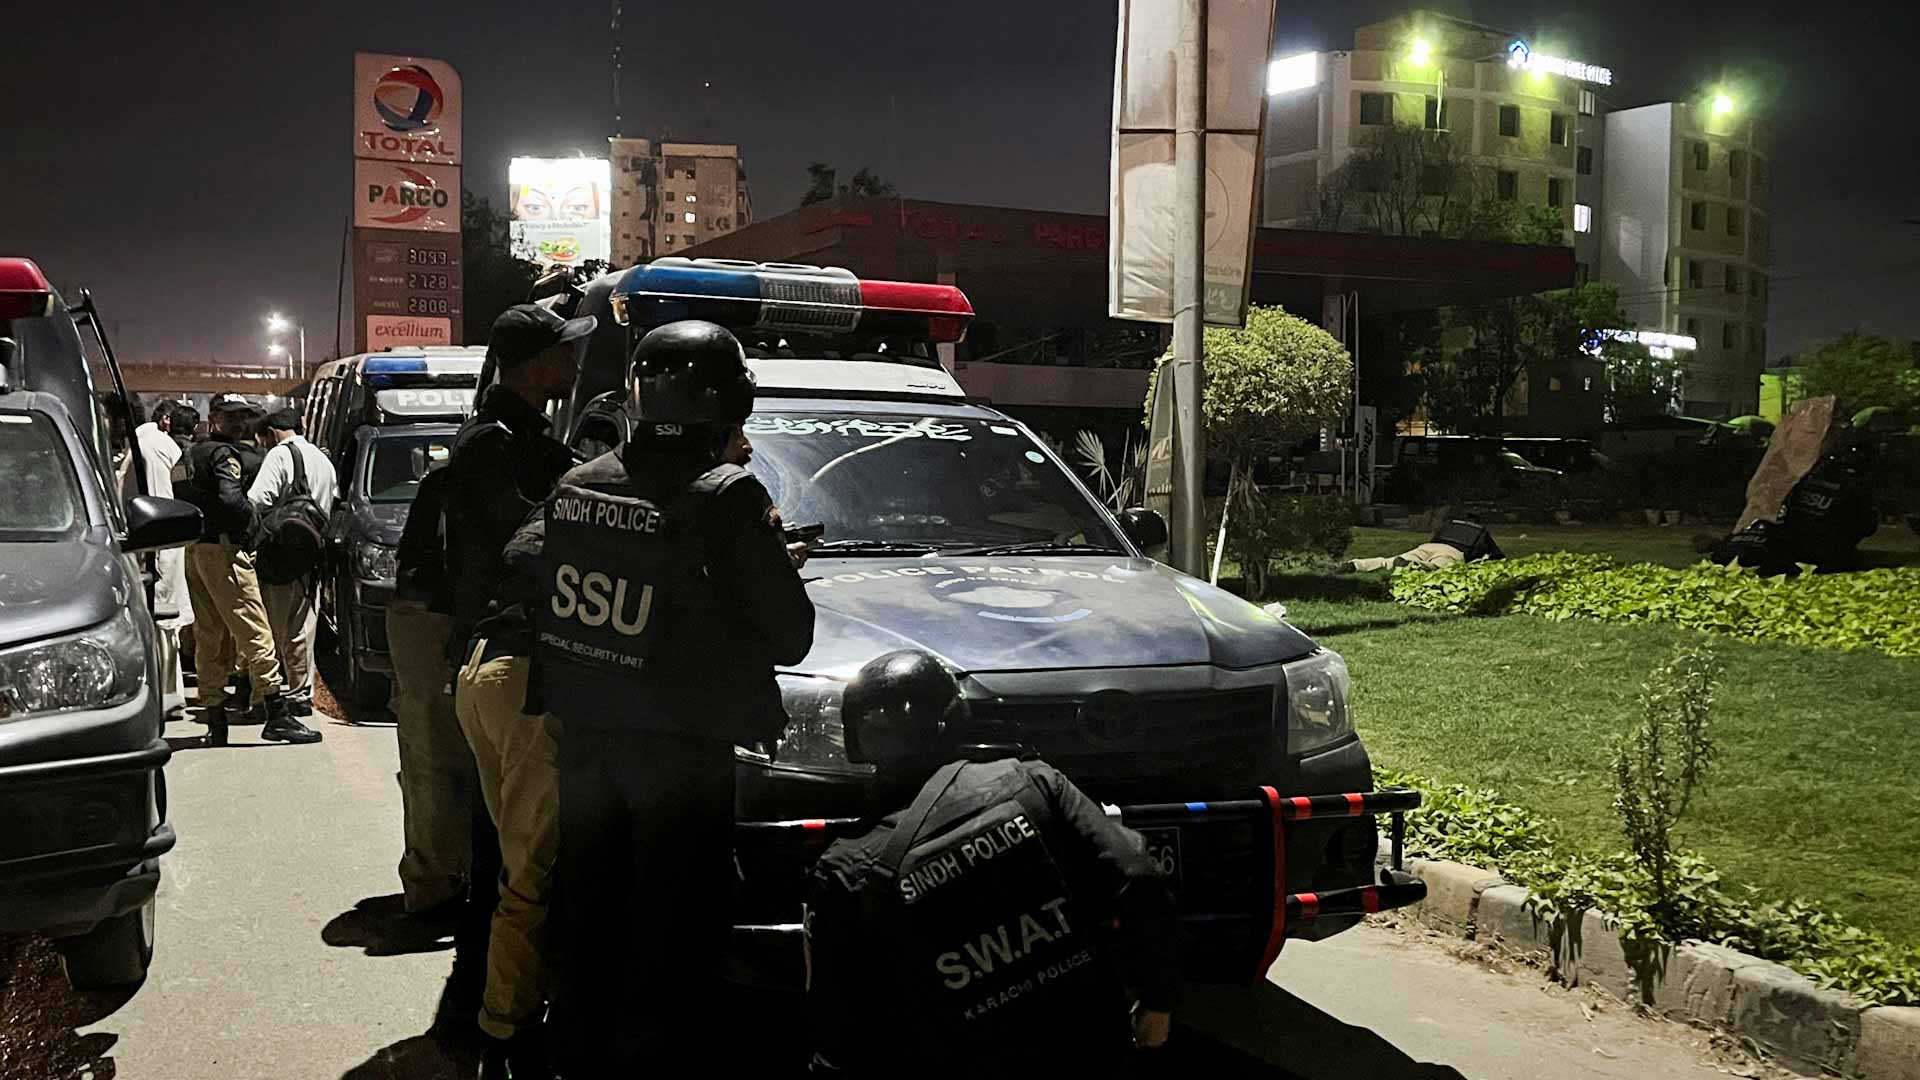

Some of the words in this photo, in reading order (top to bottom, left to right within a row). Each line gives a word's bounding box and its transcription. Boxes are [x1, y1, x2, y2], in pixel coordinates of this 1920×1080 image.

[362, 131, 454, 155] TOTAL
[368, 184, 448, 208] PARCO
[1033, 223, 1106, 249] PARC
[375, 320, 443, 338] excellium
[397, 390, 476, 407] POLI
[655, 423, 683, 436] SSU
[552, 497, 592, 524] SINDH
[595, 501, 658, 533] POLICE
[811, 566, 953, 588] POLICE
[958, 565, 1126, 584] PATROL
[551, 563, 654, 636] SSU
[571, 641, 619, 663] SECURITY
[619, 653, 645, 669] UNIT
[900, 852, 963, 900] SINDH
[961, 815, 1036, 867] POLICE
[935, 896, 1071, 990] S.W.A.T
[963, 979, 1033, 1022] KARACHI
[1037, 950, 1092, 984] POLICE
